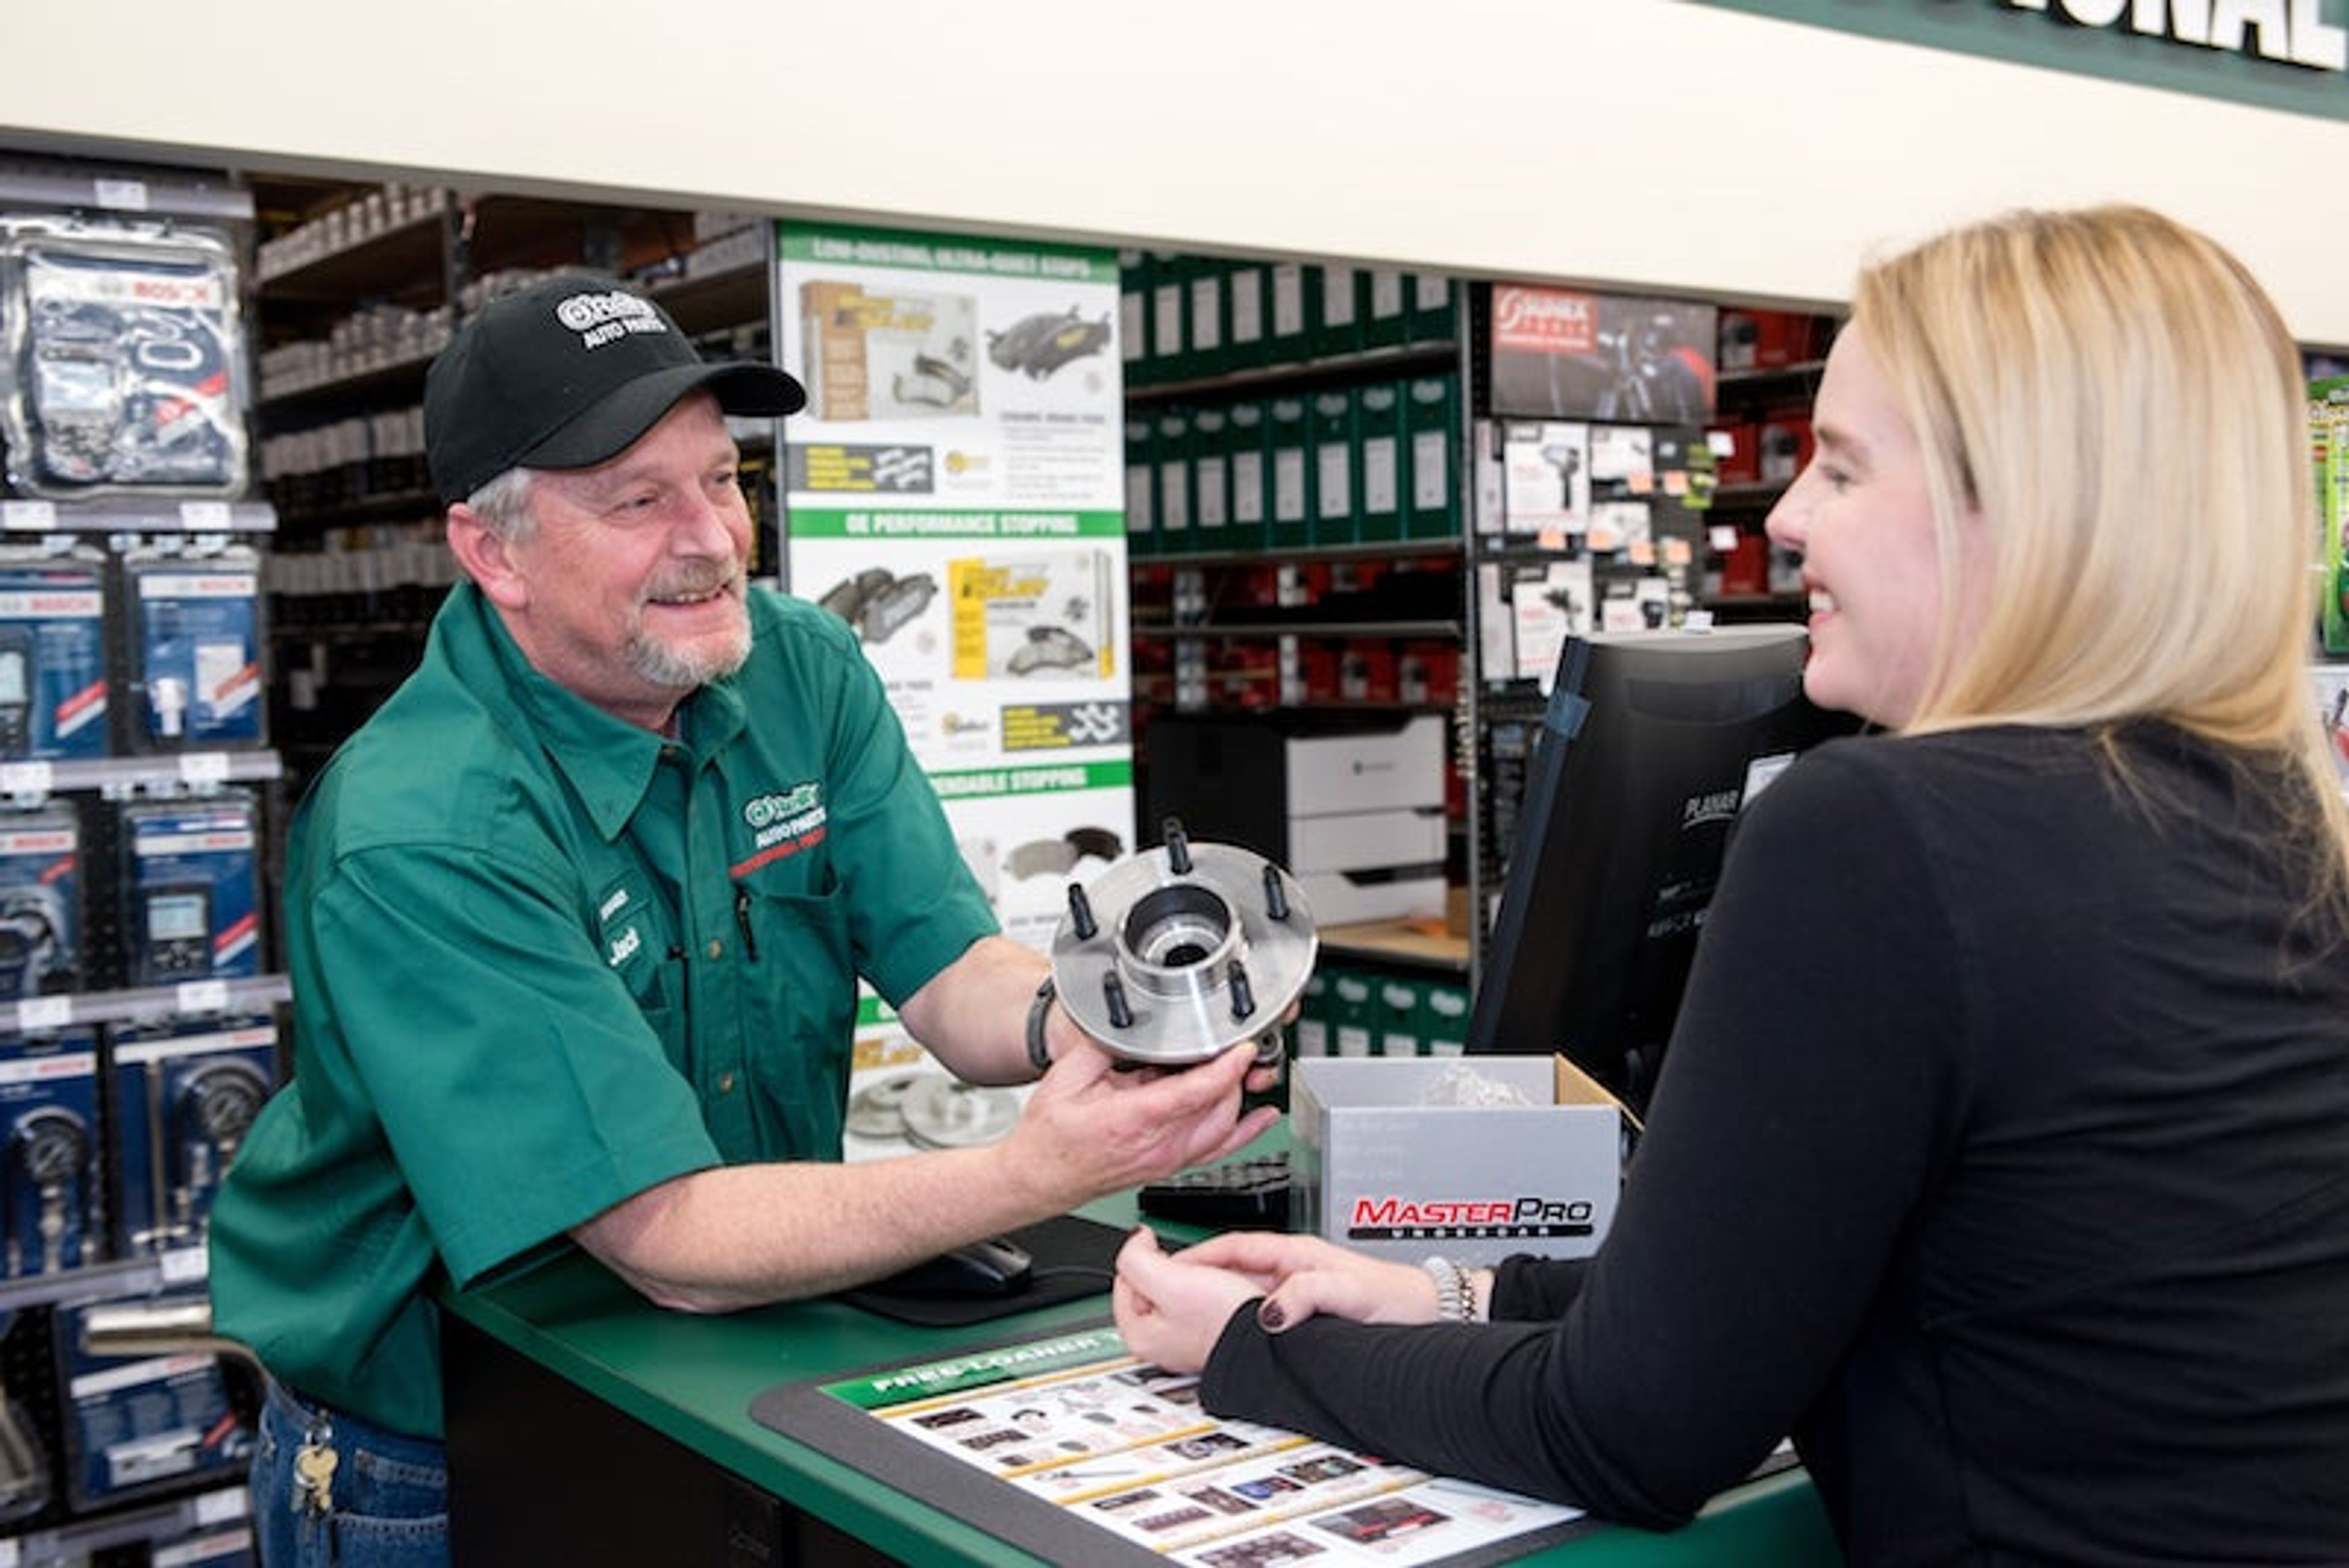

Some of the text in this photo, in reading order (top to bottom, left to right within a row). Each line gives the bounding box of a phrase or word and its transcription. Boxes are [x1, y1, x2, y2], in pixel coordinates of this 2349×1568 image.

[131, 281, 209, 300] BOSCH
[583, 321, 625, 349] AUTO
[1000, 515, 1079, 534] STOPPING
[933, 767, 1086, 795] ENDABLE STOPPING
